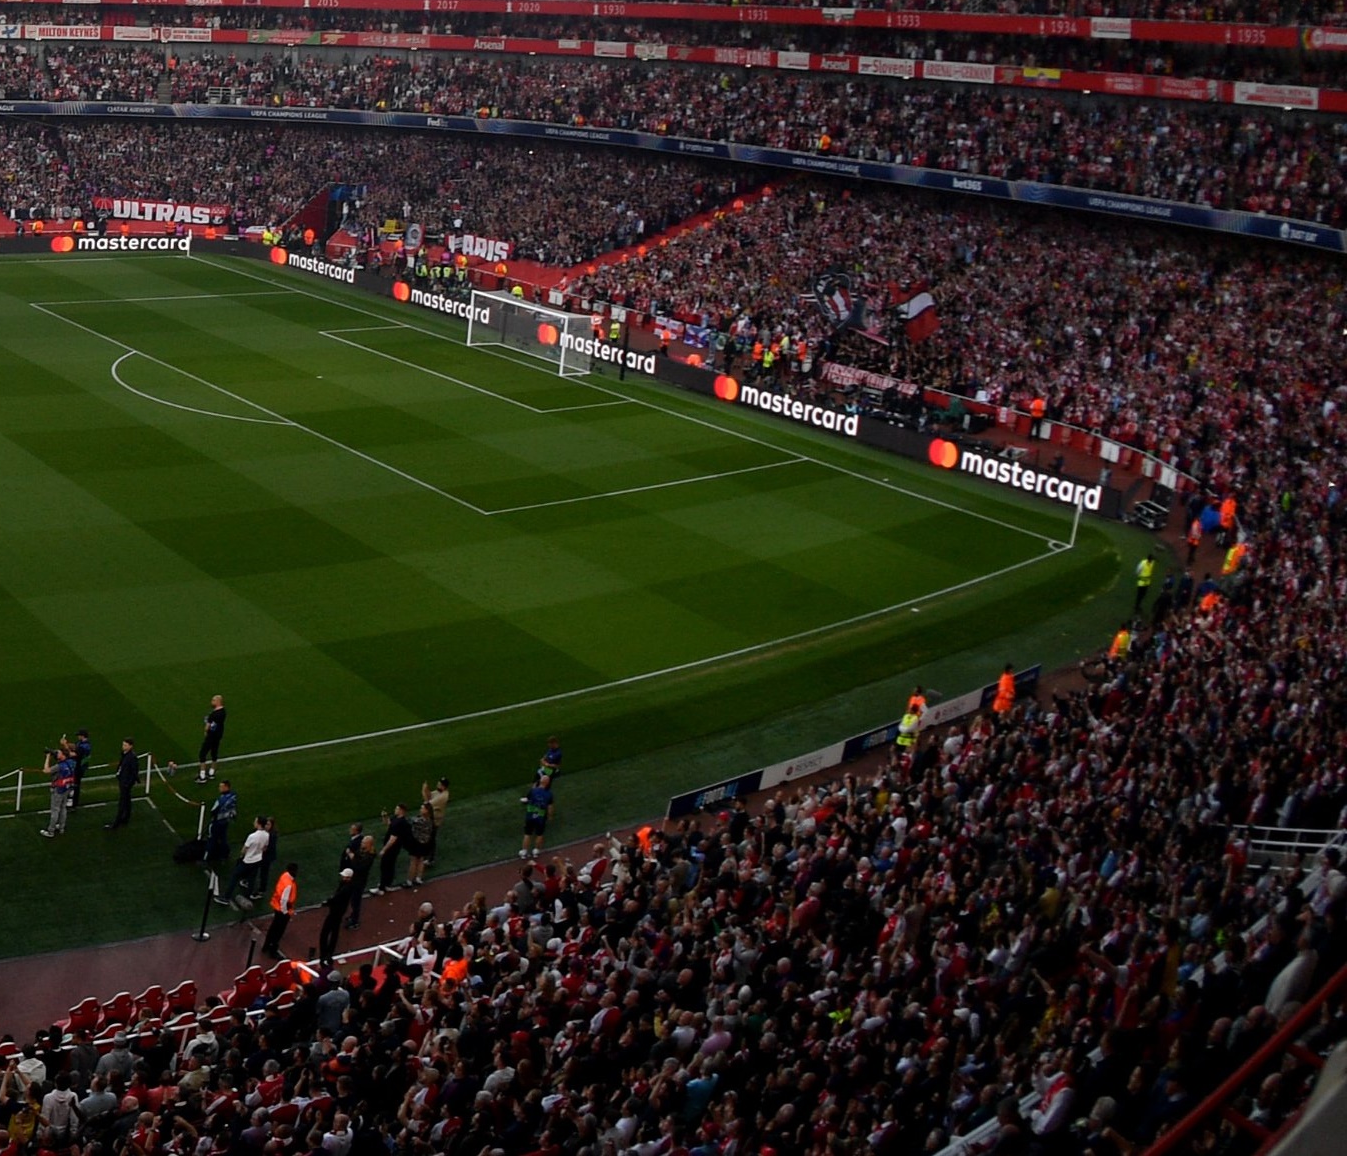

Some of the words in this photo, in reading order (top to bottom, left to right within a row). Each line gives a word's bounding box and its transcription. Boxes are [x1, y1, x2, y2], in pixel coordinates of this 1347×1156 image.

[437, 0, 459, 10] 2017
[518, 2, 541, 12] 2020
[603, 5, 625, 15] 1930
[747, 10, 768, 20] 1931
[897, 15, 921, 26] 1933
[39, 26, 67, 37] MILTON
[69, 26, 99, 38] KEYNES
[1051, 22, 1077, 34] 1934
[1237, 30, 1265, 44] 1935
[473, 38, 505, 50] Arsenal
[821, 56, 849, 71] Arsenal
[873, 59, 913, 76] Slovenia
[953, 178, 981, 191] bet365
[113, 200, 212, 224] ULTRAS
[78, 235, 190, 251] mastercard
[289, 252, 355, 284] mastercard
[740, 384, 859, 438] mastercard
[961, 448, 1102, 512] mastercard
